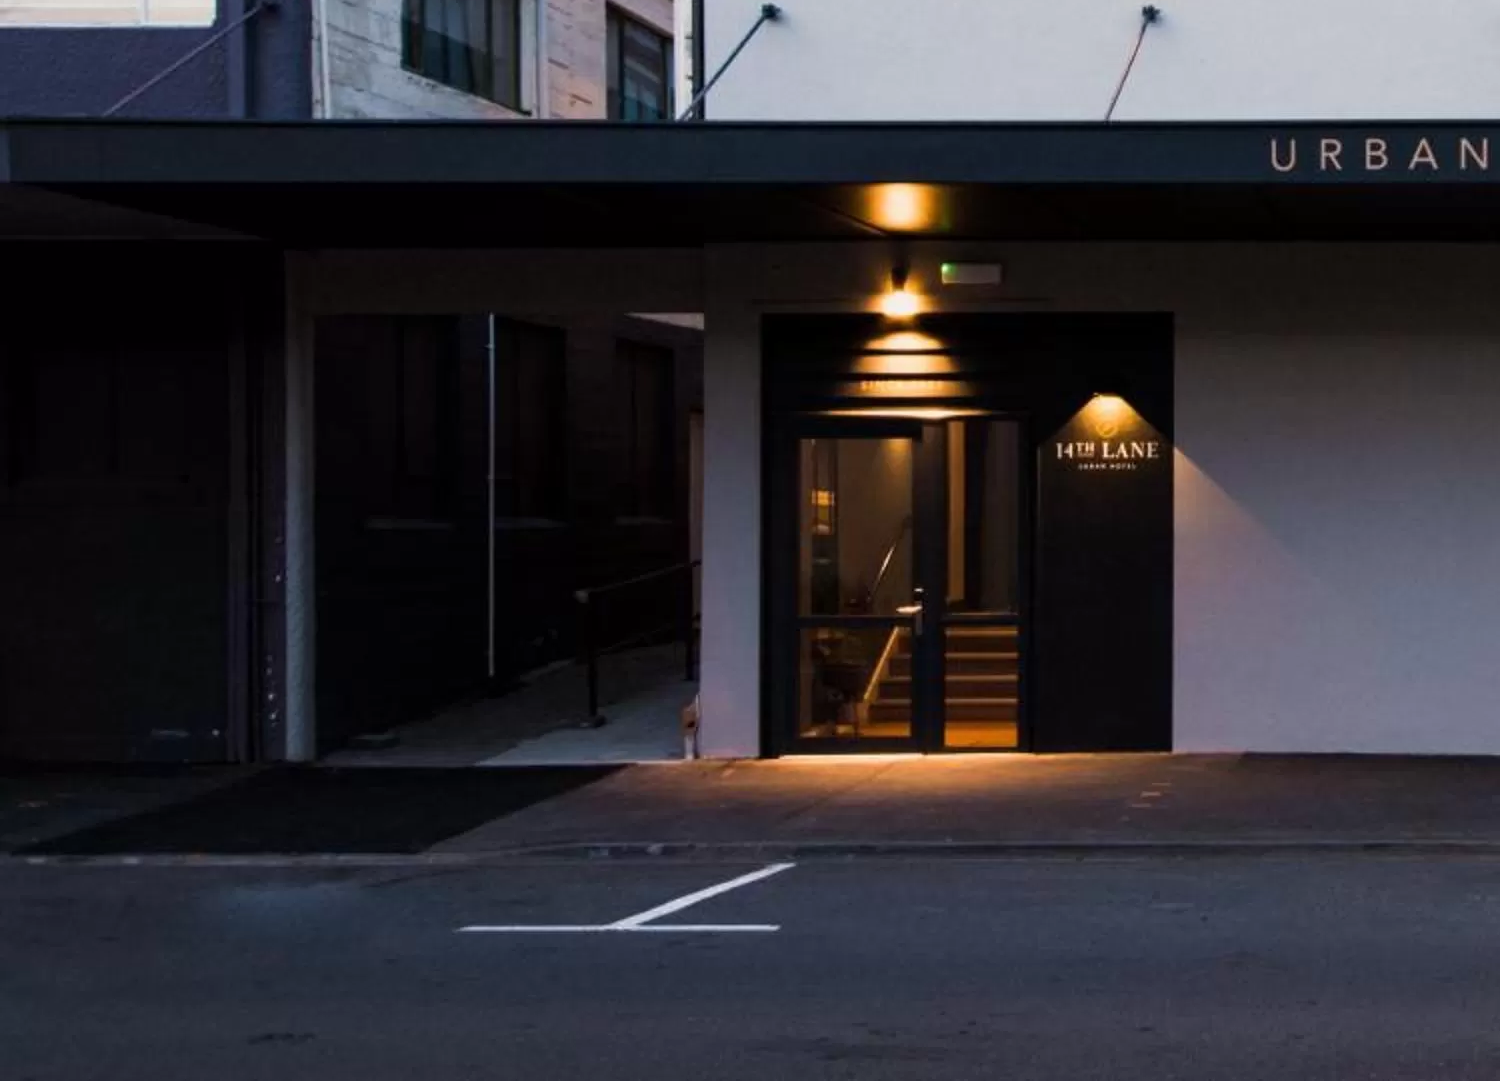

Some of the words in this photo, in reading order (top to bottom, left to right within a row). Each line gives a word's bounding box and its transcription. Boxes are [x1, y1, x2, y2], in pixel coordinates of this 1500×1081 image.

[1270, 137, 1489, 172] URBAN
[1056, 441, 1095, 459] 14TH
[1102, 441, 1160, 459] LANE
